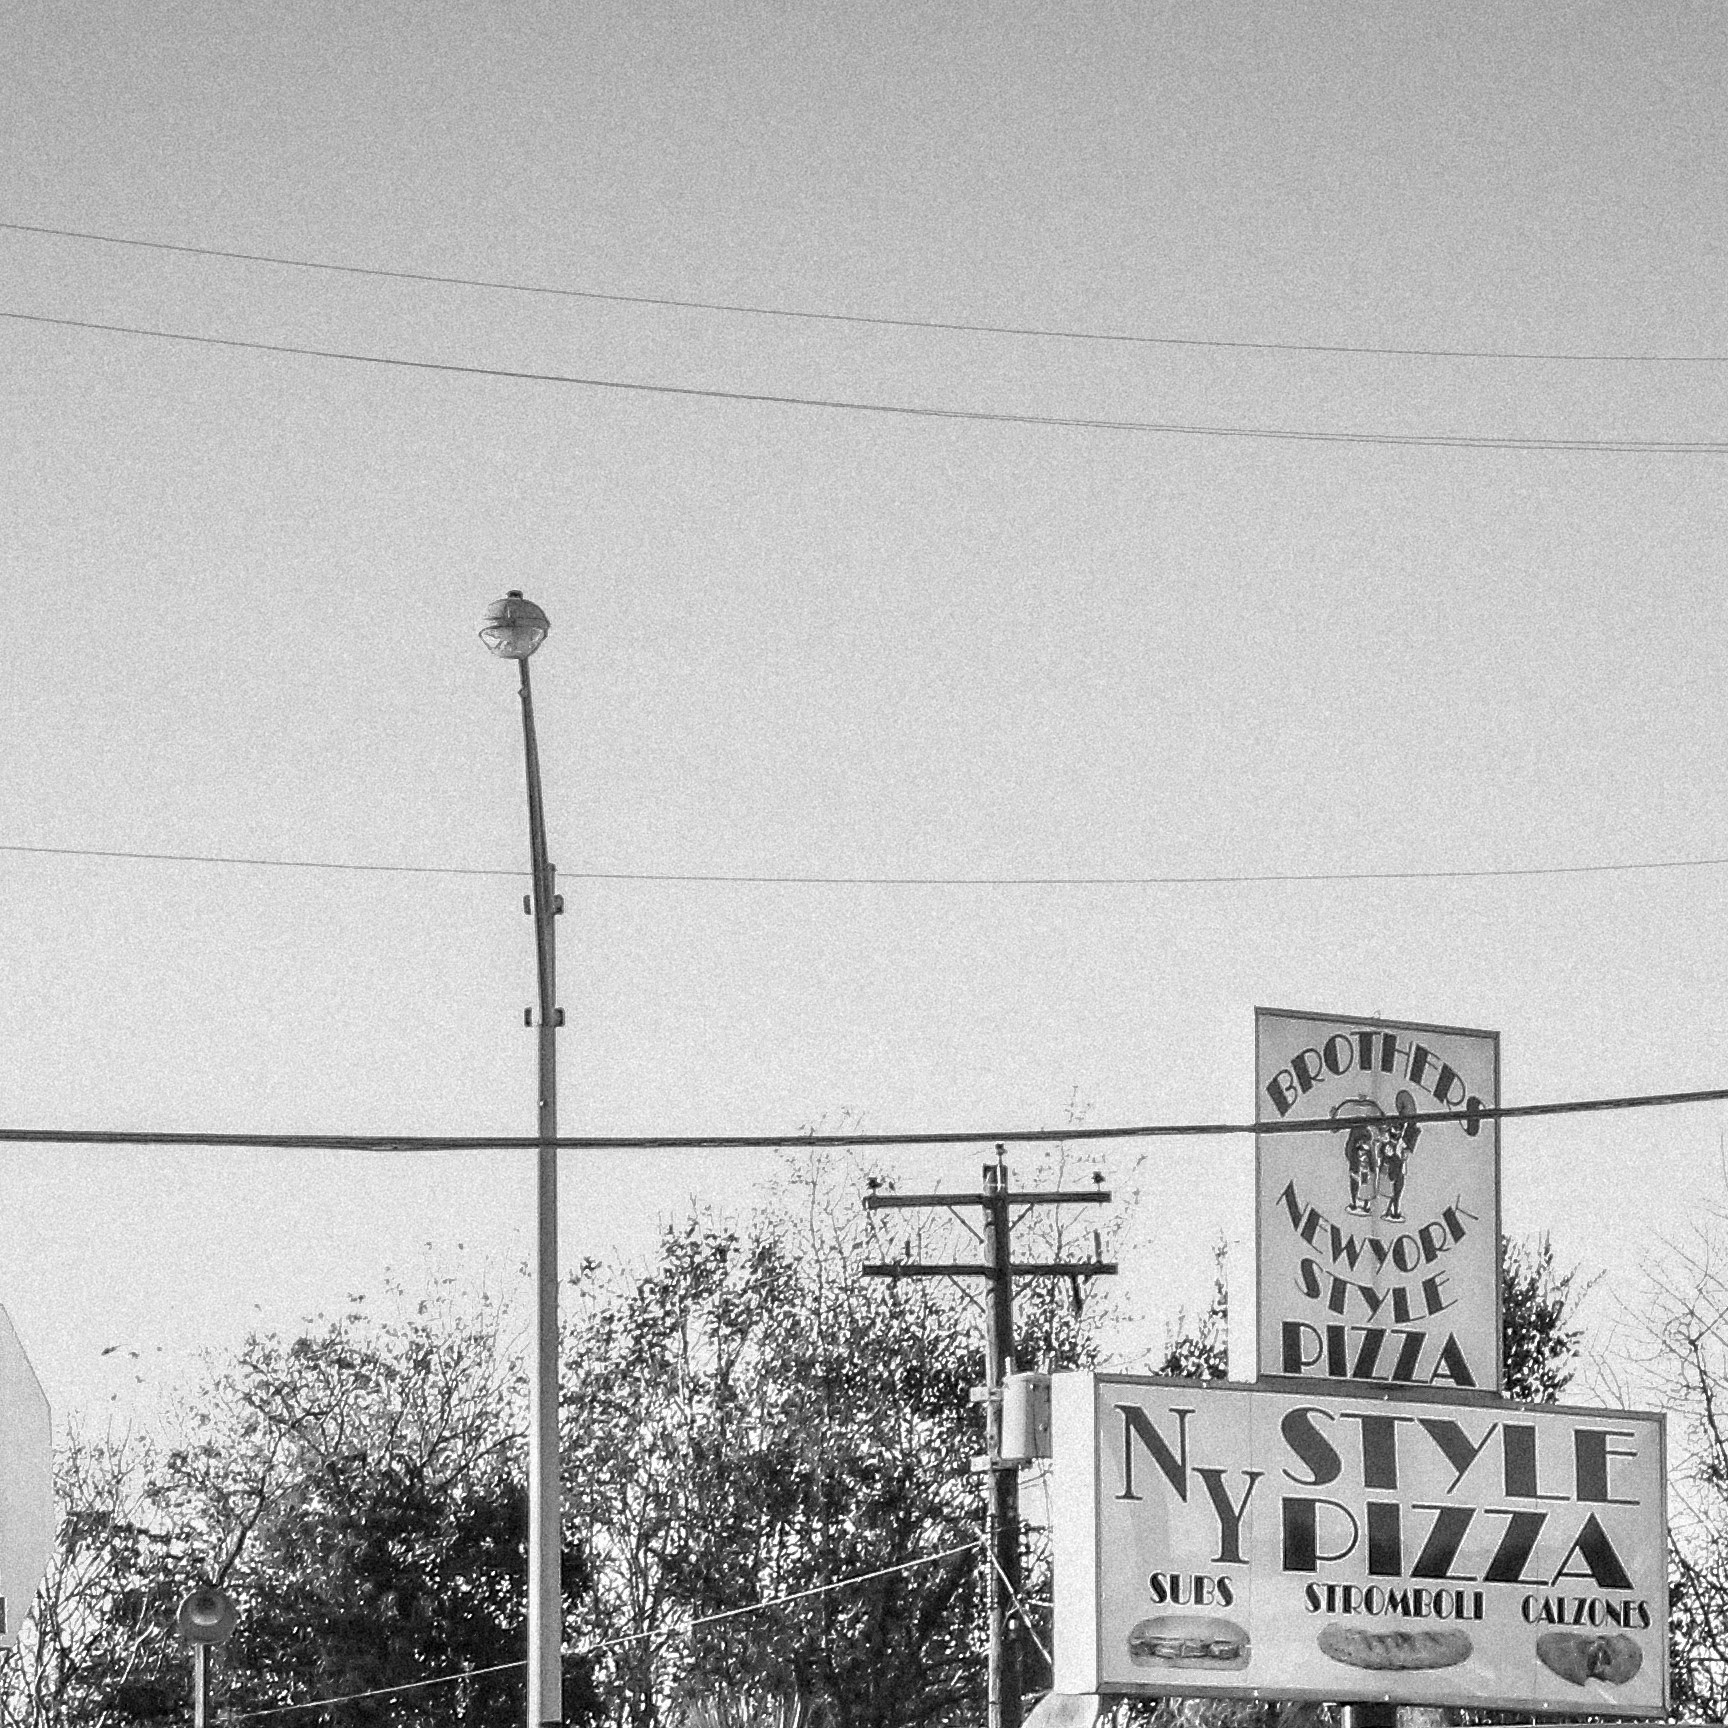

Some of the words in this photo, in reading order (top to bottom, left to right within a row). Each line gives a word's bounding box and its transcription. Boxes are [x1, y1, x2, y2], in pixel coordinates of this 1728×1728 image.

[1266, 1031, 1486, 1137] BROTHERS
[1294, 1257, 1459, 1324] STYLE
[1281, 1320, 1478, 1388] PIZZA
[1280, 1406, 1641, 1505] STYLE
[1281, 1496, 1635, 1590] PIZZA
[1149, 1571, 1234, 1607] SUBS
[1304, 1582, 1485, 1621] STROMBOLI
[1520, 1594, 1651, 1630] CALZONES
